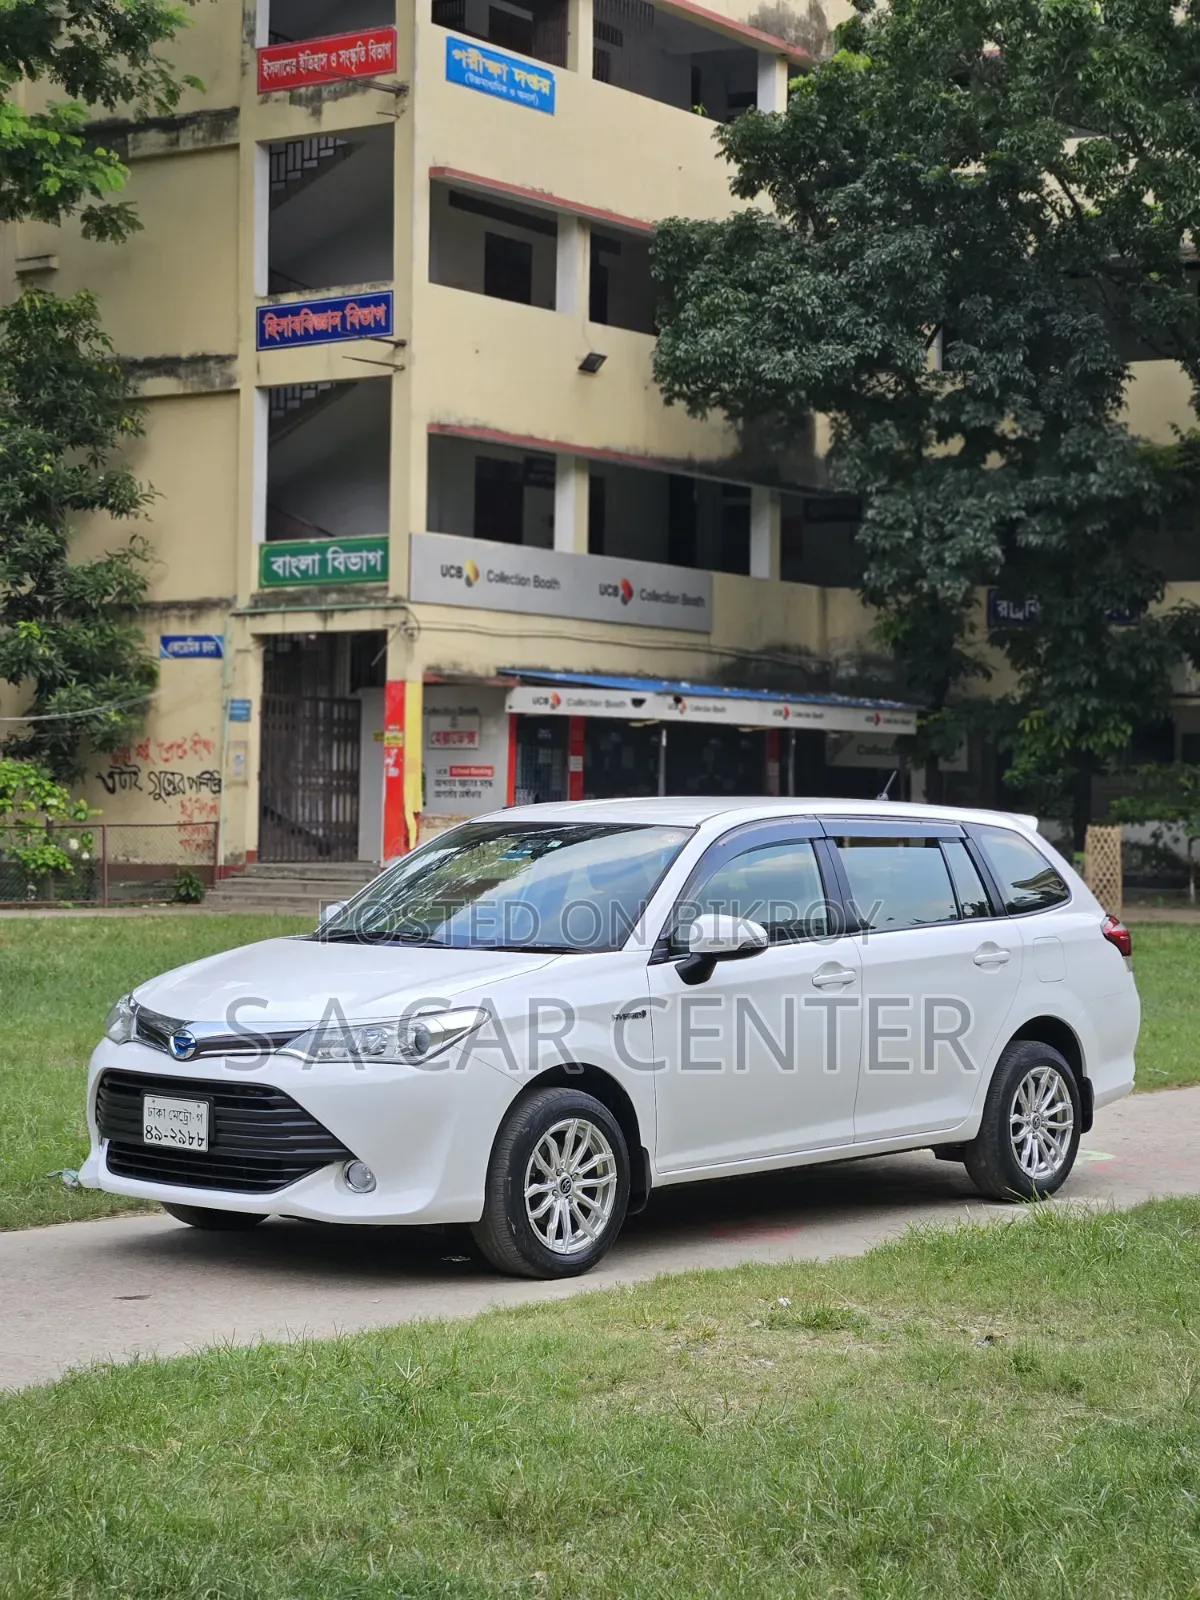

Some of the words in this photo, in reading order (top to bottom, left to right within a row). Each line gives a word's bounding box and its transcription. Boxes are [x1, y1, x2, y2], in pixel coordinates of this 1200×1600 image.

[263, 58, 297, 81] ইসলামের
[299, 50, 328, 75] ইতিহাস
[330, 52, 338, 67] ও
[339, 41, 366, 73] সংস্কৃতি
[368, 39, 392, 62] বিভাগ
[452, 47, 508, 82] পরীক্ষা
[263, 308, 343, 341] হিসাববিজ্ঞান
[344, 302, 387, 330] বিভাগ
[270, 553, 321, 578] বাংলা
[326, 546, 384, 574] বিভাগ
[441, 564, 463, 579] UCB
[486, 569, 531, 588] Collection
[533, 575, 561, 591] Booth
[598, 583, 619, 598] UCB
[639, 588, 680, 603] Collection
[681, 593, 706, 608] Booth
[147, 1106, 166, 1119] ঢাকা
